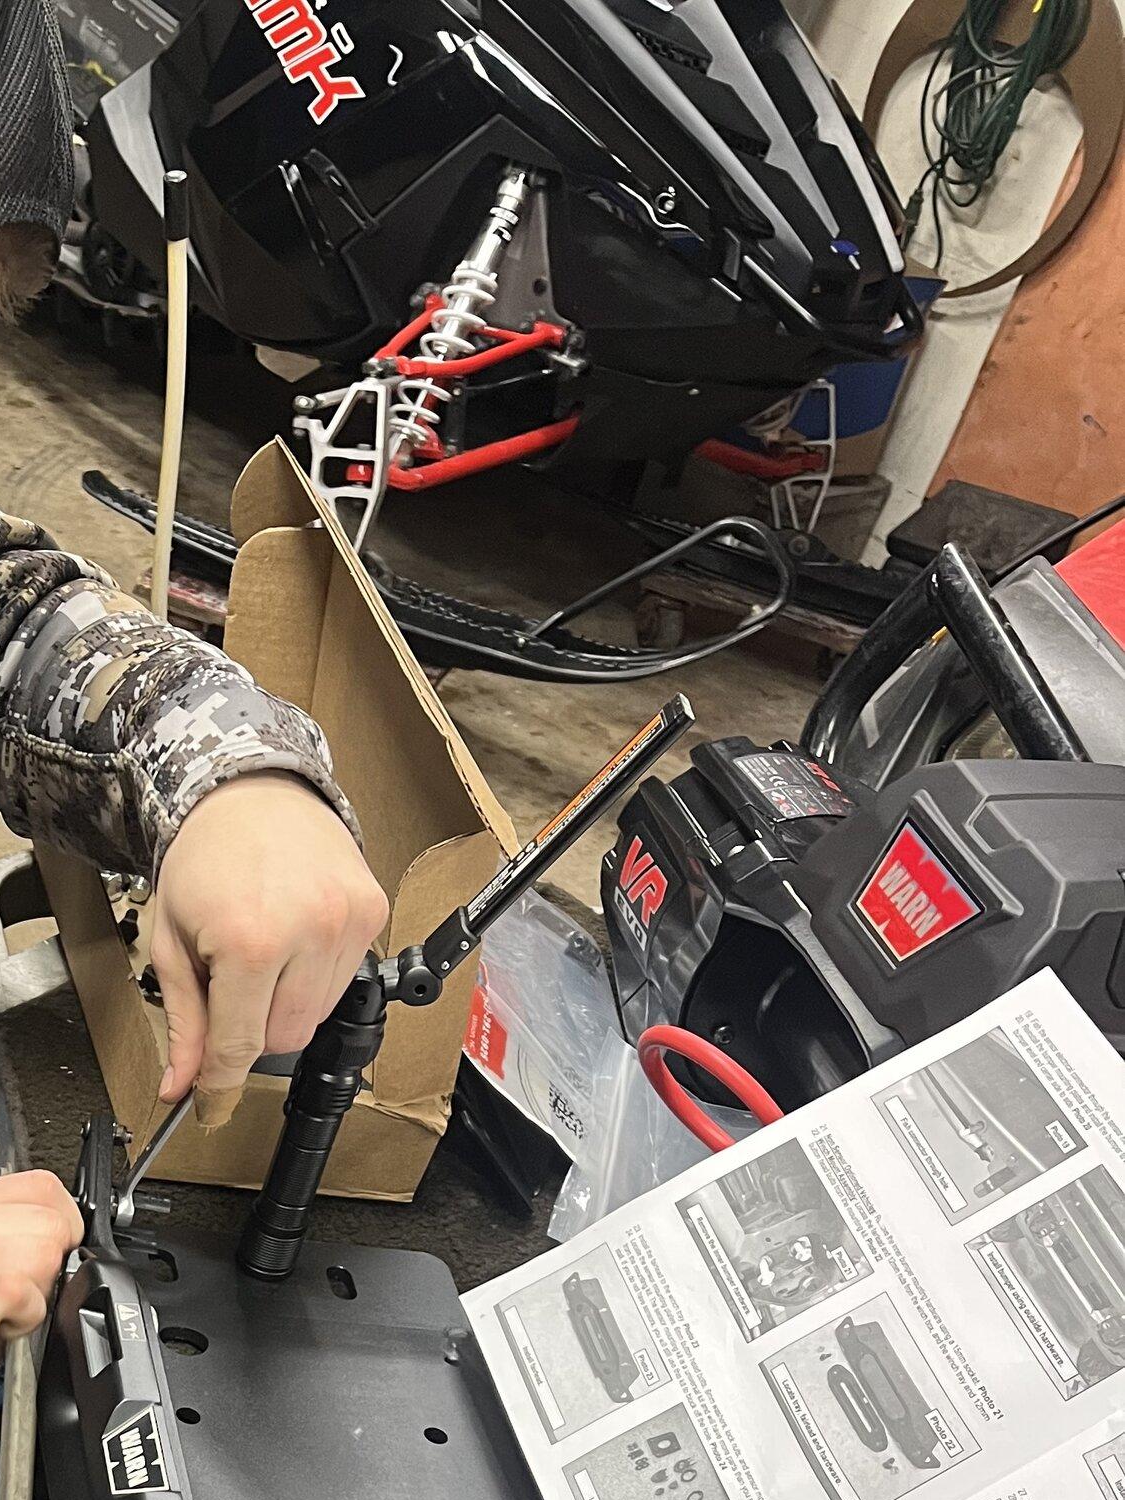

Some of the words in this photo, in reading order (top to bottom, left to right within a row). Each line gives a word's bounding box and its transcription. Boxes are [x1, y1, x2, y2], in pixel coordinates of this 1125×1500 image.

[242, 0, 366, 125] MK
[620, 835, 668, 929] VR
[878, 859, 943, 939] WARN
[996, 1267, 1016, 1292] bumper
[1011, 1290, 1028, 1310] using
[781, 1378, 797, 1400] Locate
[799, 1413, 817, 1438] fairlead
[811, 1436, 824, 1451] and
[930, 1415, 949, 1439] Photo
[945, 1439, 955, 1450] 22
[963, 1383, 977, 1398] and
[972, 1398, 991, 1422] 12mm
[977, 1385, 997, 1409] Photo
[992, 1408, 1004, 1419] 21
[120, 1427, 149, 1488] WARN
